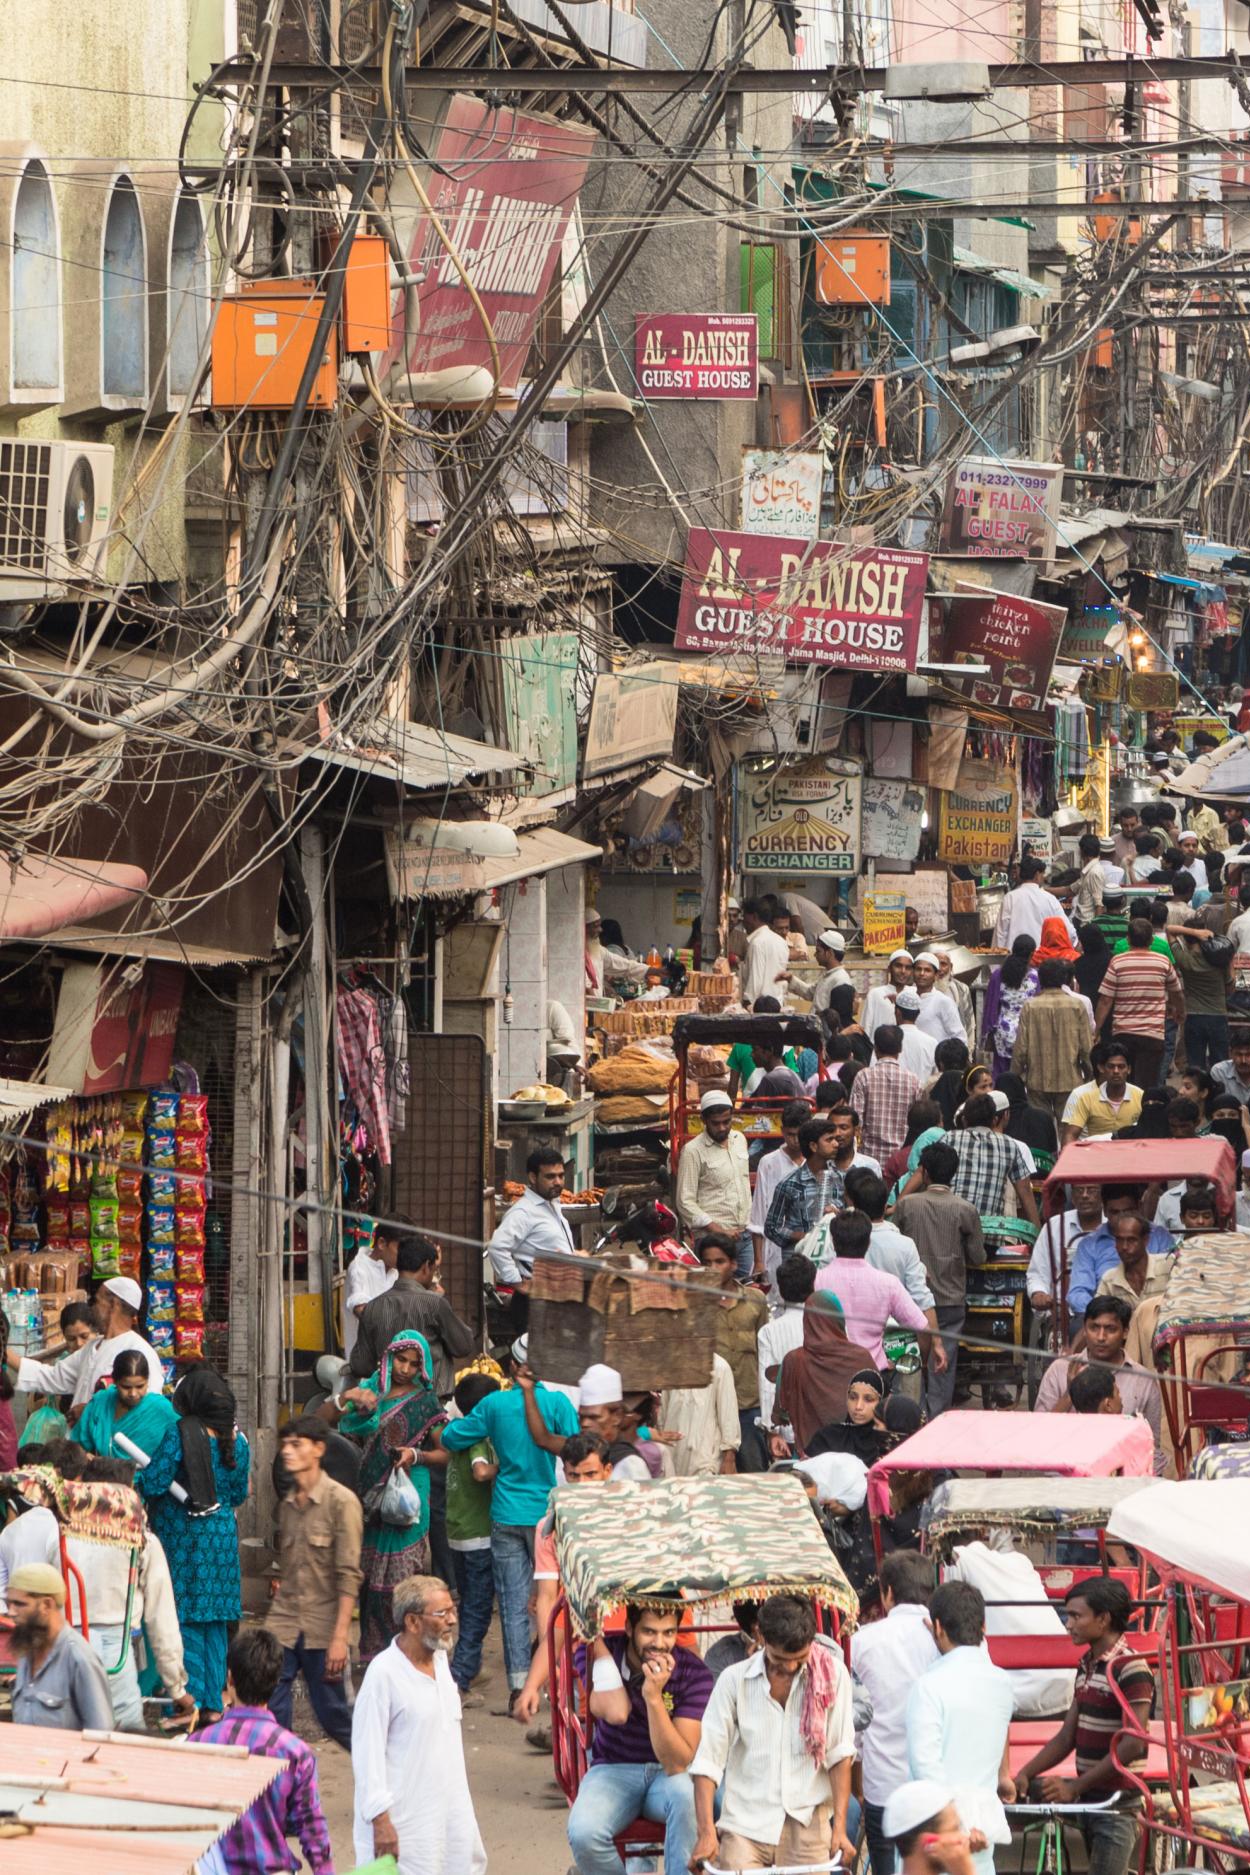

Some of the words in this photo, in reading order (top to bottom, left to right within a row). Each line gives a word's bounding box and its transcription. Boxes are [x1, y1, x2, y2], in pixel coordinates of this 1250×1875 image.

[642, 330, 667, 365] AL
[682, 330, 750, 366] DANISH
[642, 370, 693, 388] GUEST
[697, 370, 751, 388] HOUSE
[968, 518, 1029, 541] GUEST
[699, 547, 743, 600] AL
[775, 553, 909, 618] DANISH
[695, 605, 793, 640] GUEST
[801, 617, 904, 652] HOUSE
[980, 614, 1031, 635] chicken
[983, 631, 1021, 648] point
[789, 647, 813, 658] Jama
[788, 779, 831, 790] PAKISTANI
[948, 791, 1012, 814] CURRENCY
[948, 815, 1011, 833] EXCHANGER
[748, 834, 850, 852] CURRENCY
[944, 835, 1012, 858] Pakistani
[747, 854, 852, 869] EXCHANGER
